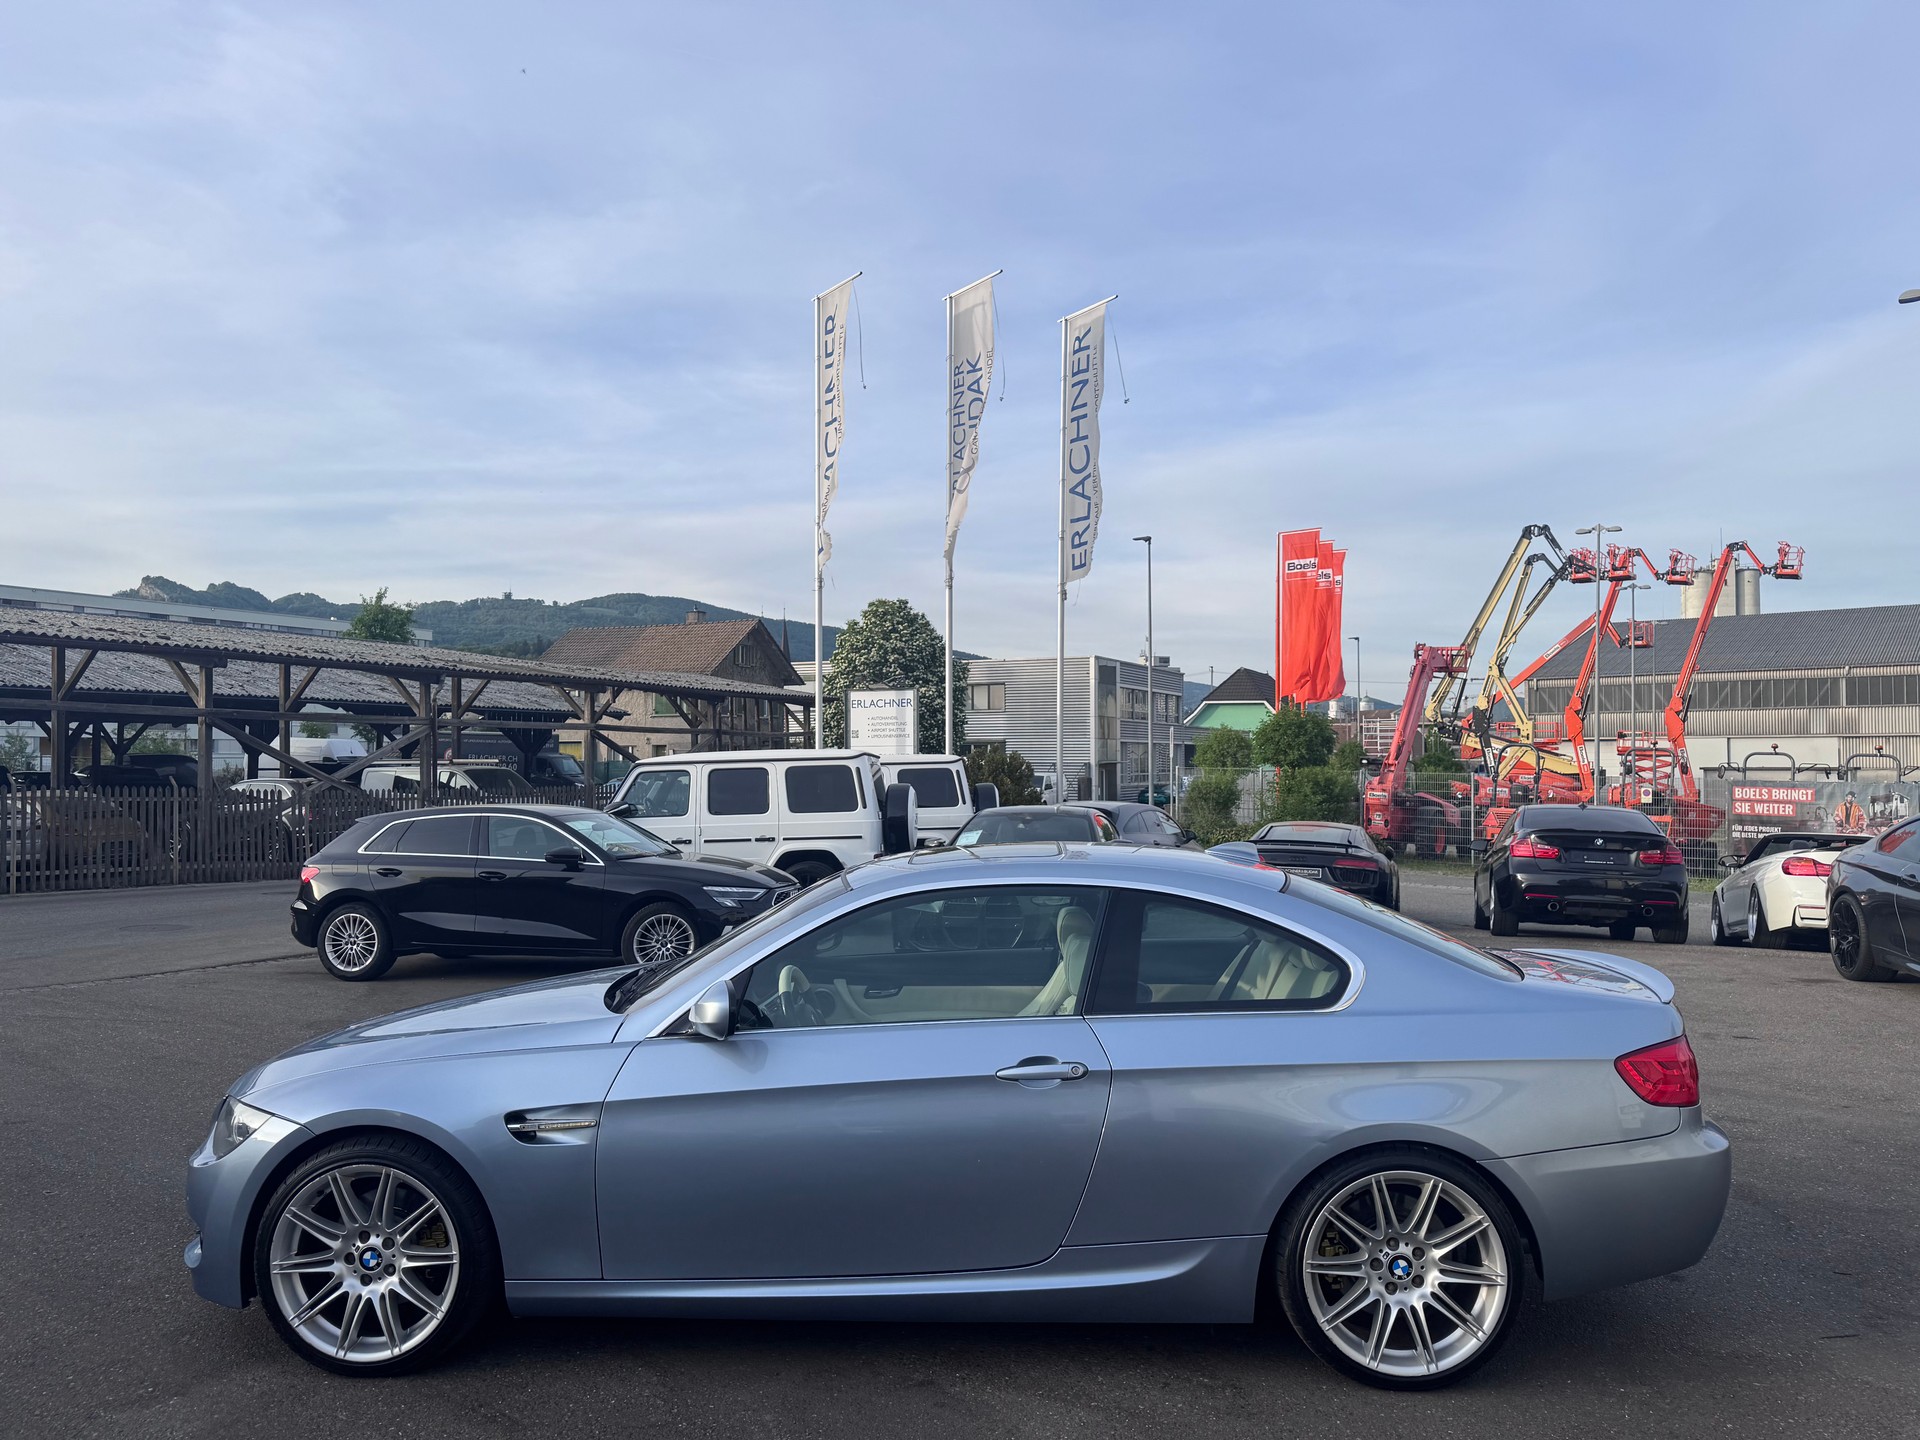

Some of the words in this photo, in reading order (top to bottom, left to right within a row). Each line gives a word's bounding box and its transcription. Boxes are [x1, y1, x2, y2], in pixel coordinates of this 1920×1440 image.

[1069, 326, 1093, 571] ERLACHNER
[851, 698, 913, 709] ERLACHNER
[1735, 788, 1769, 799] BOELS
[1771, 789, 1813, 801] BRINGT
[1735, 802, 1751, 813] SIE
[1754, 803, 1794, 815] WEITER
